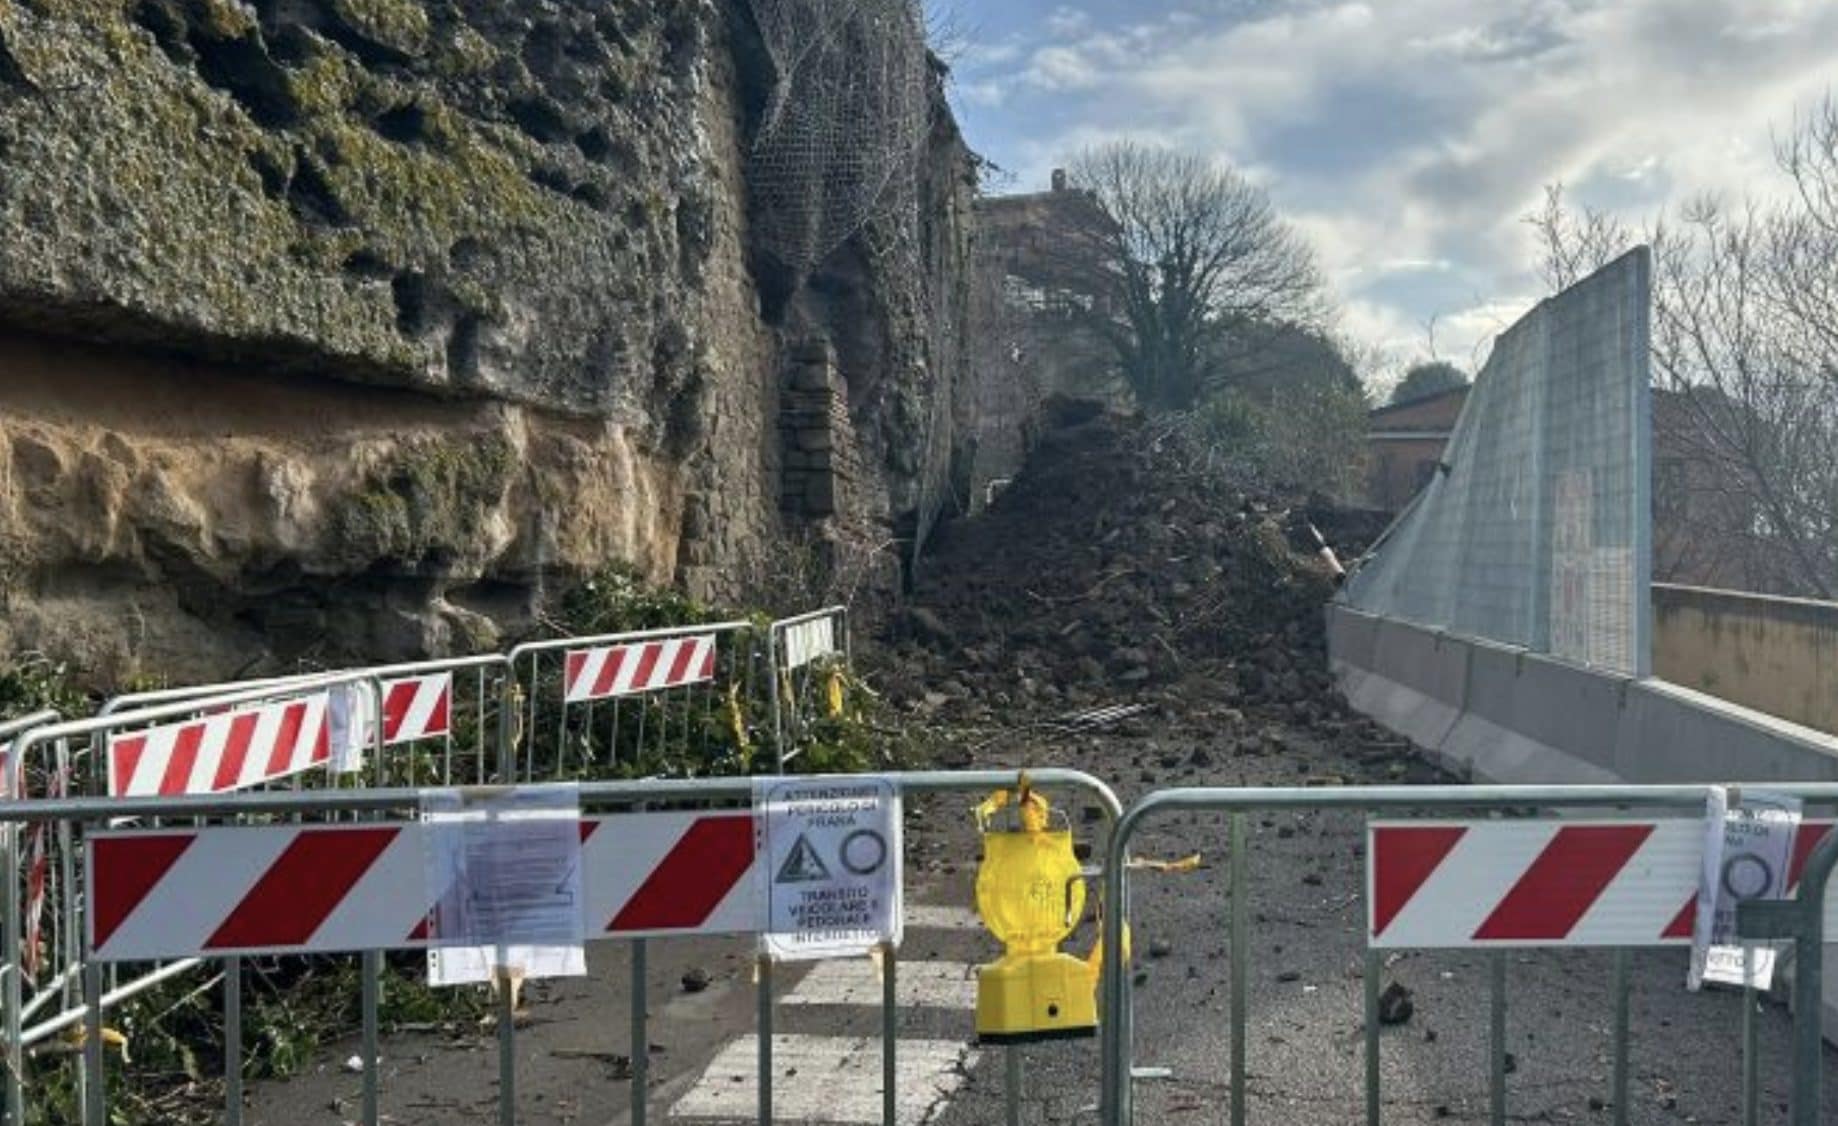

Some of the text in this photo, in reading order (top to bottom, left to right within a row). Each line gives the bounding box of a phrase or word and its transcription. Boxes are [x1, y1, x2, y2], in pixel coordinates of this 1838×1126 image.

[800, 886, 869, 902] TRANSITO
[788, 899, 868, 916] VEICOLARE
[796, 912, 871, 928] PEDONALE
